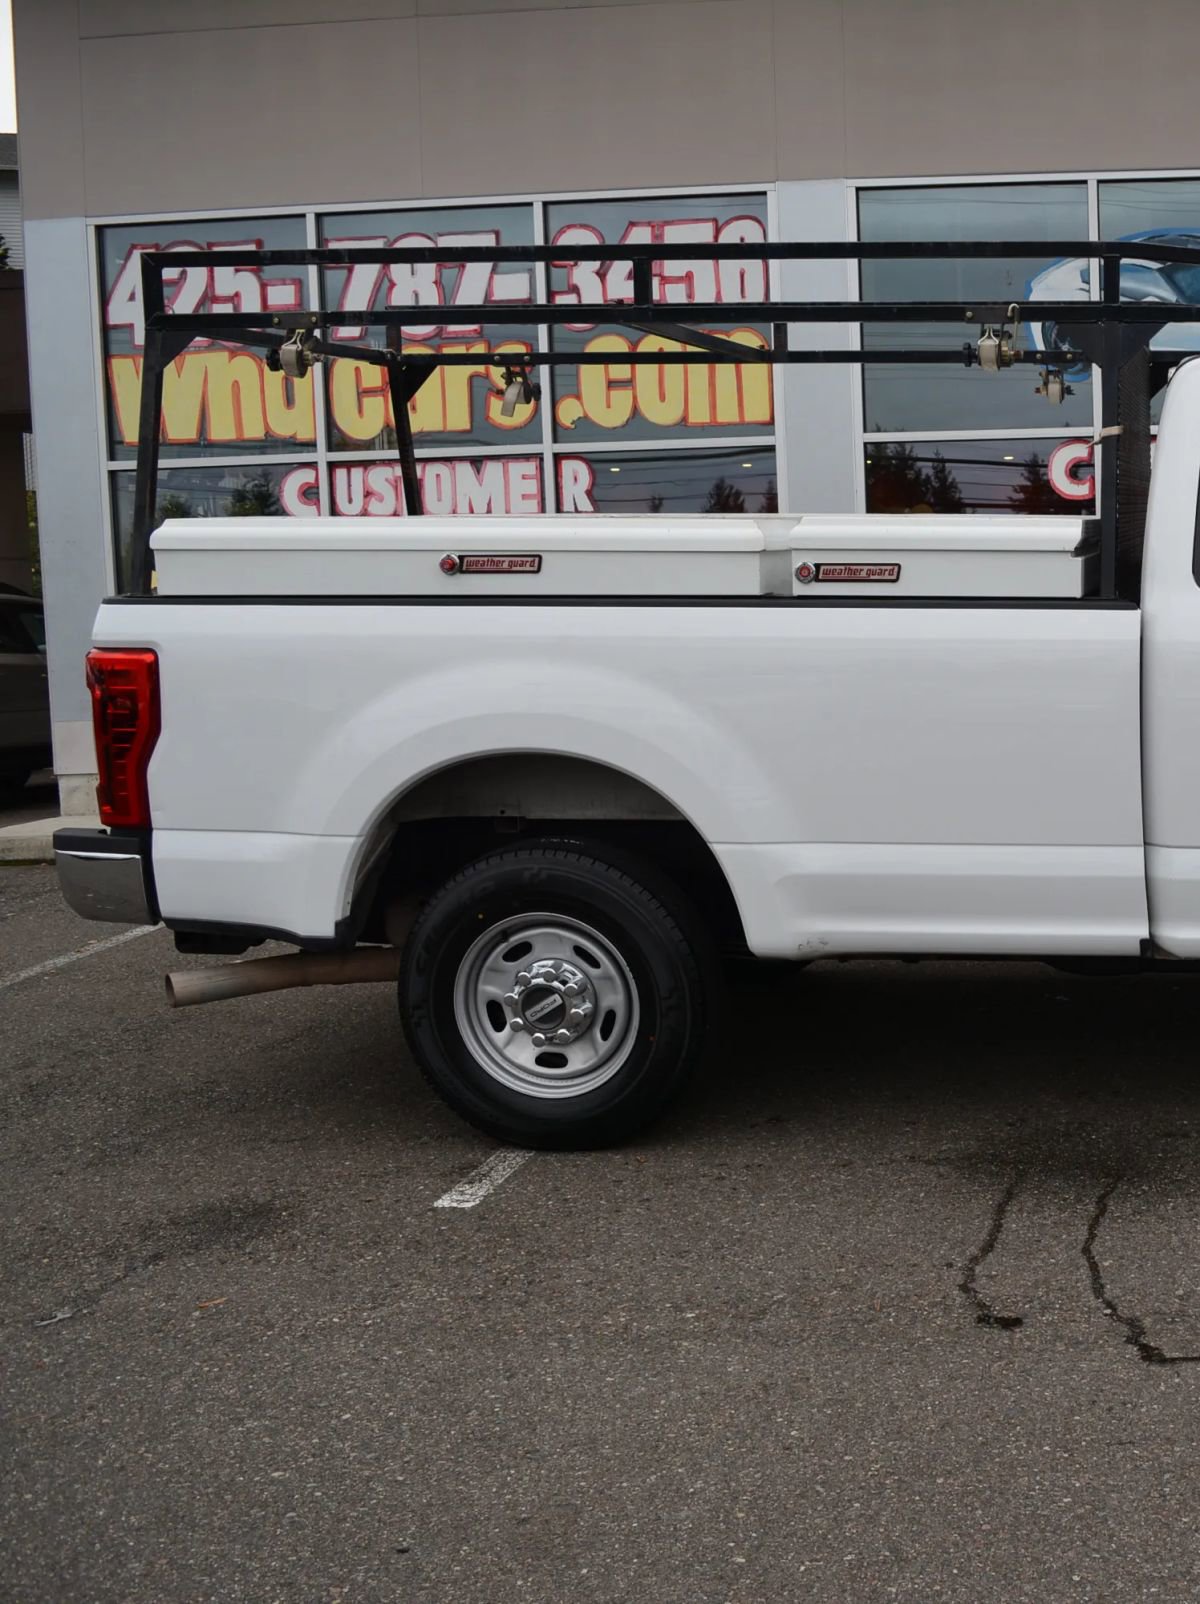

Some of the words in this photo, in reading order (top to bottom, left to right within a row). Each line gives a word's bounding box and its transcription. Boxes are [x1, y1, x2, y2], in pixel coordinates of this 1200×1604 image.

[465, 558, 507, 568] weather
[508, 558, 536, 569] guard
[822, 566, 864, 576] weather
[866, 567, 895, 577] guard
